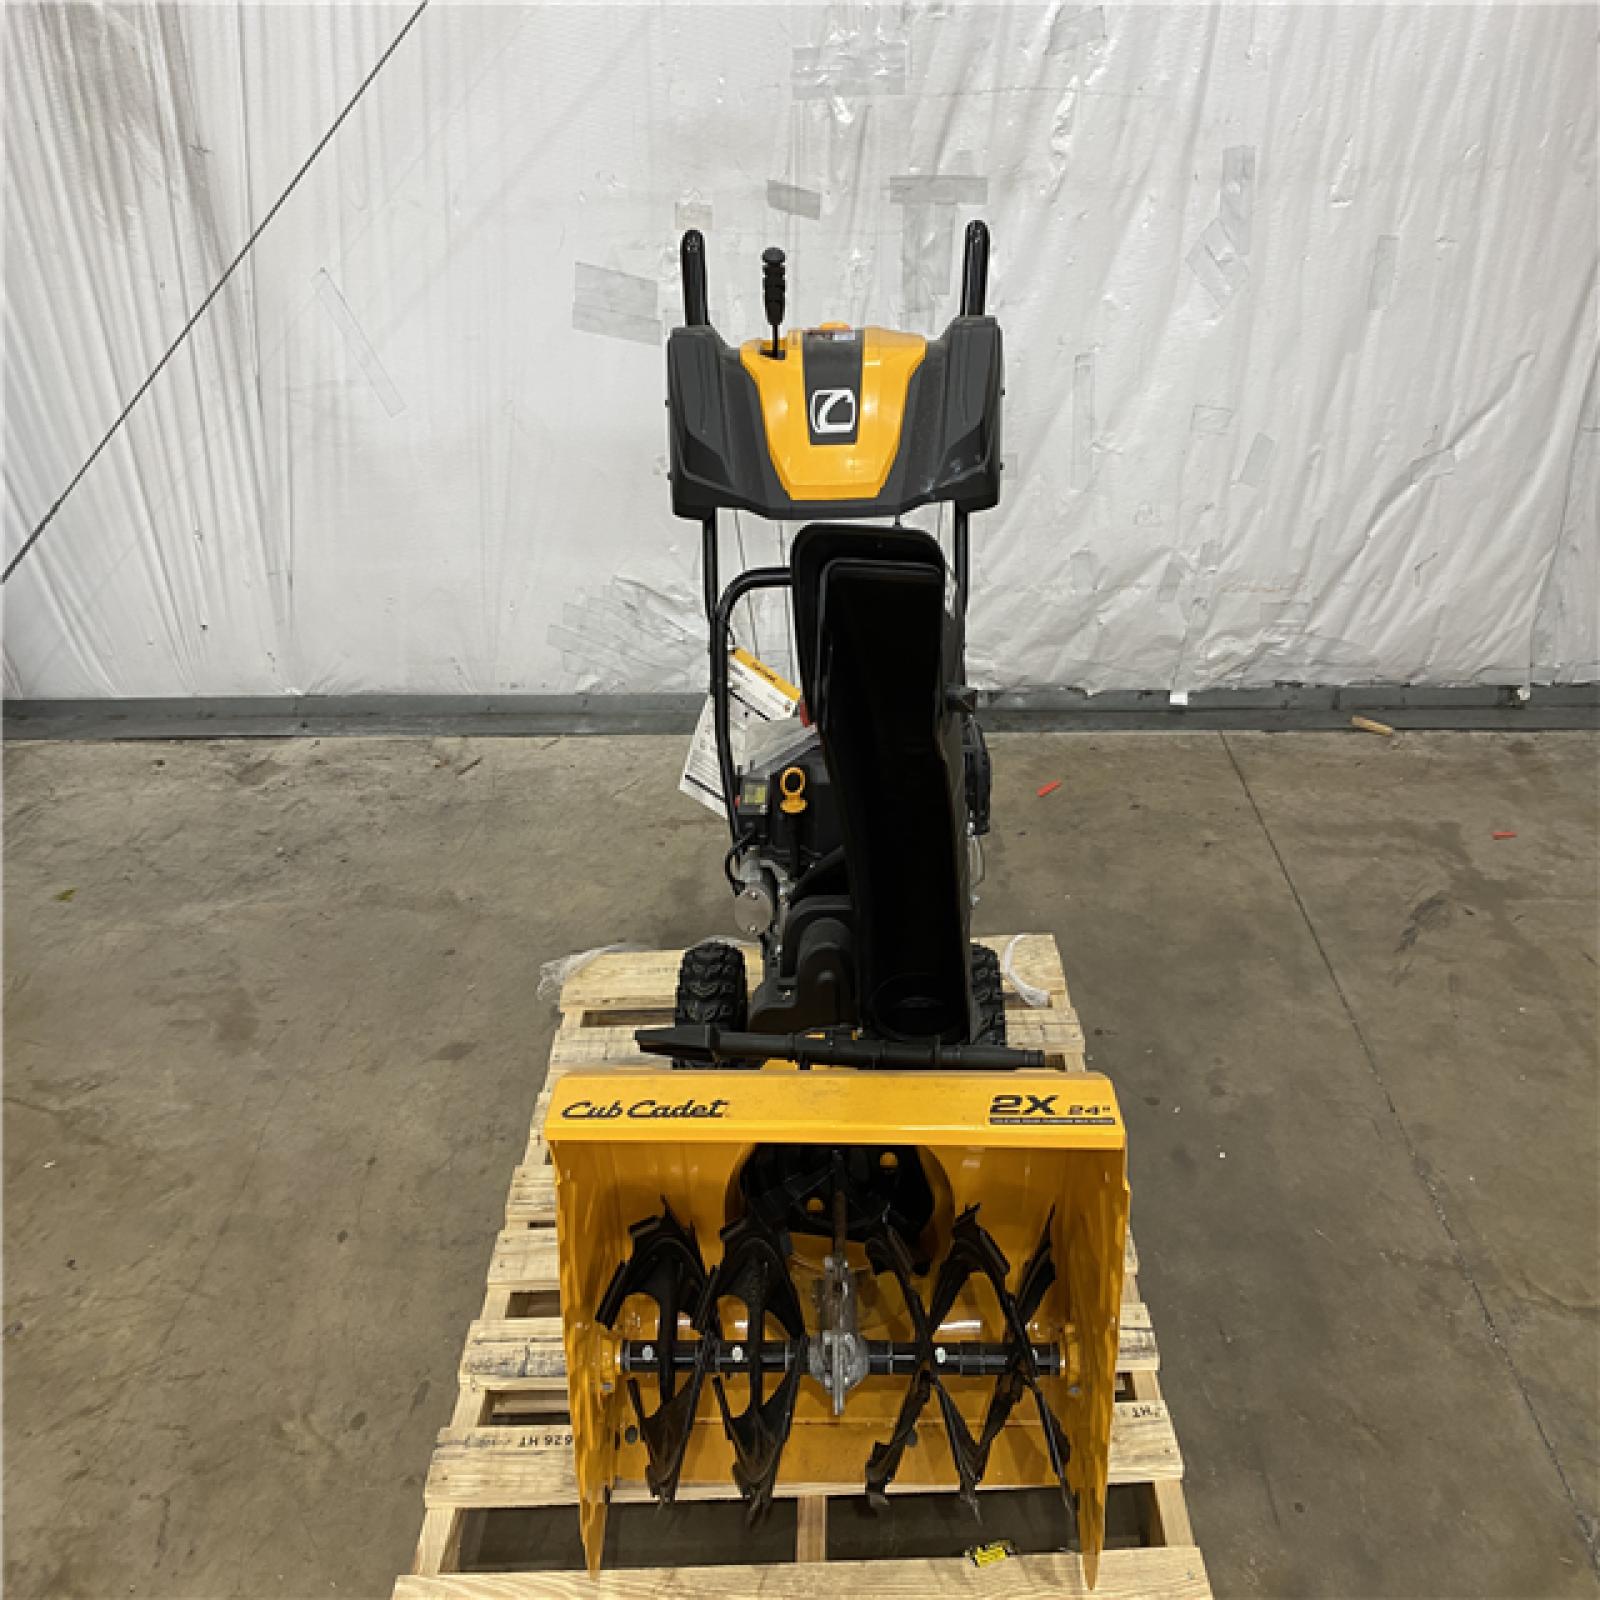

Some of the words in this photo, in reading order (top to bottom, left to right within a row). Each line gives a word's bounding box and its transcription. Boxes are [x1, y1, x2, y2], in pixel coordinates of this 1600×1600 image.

[562, 1100, 623, 1120] Cub
[627, 1099, 728, 1120] Cadet
[990, 1095, 1059, 1115] 2X
